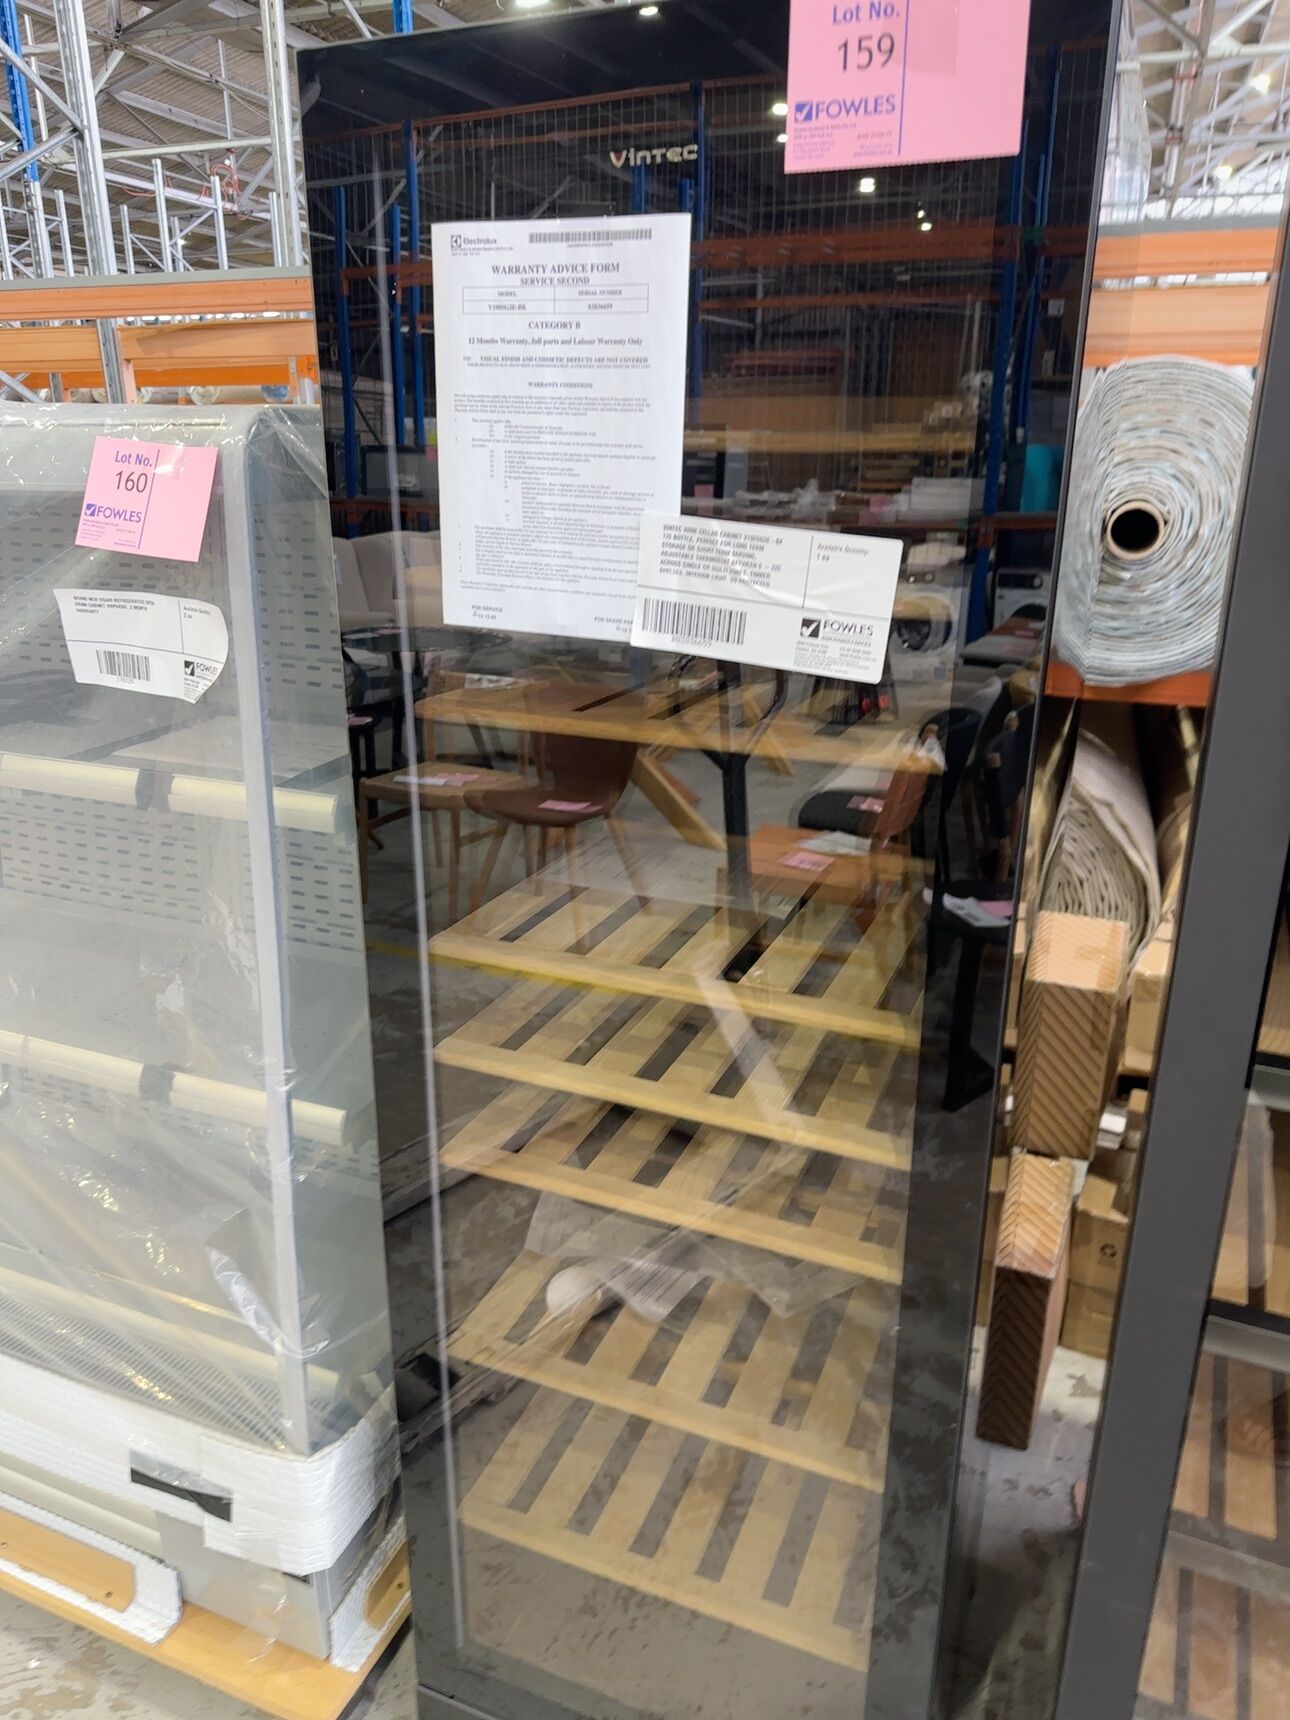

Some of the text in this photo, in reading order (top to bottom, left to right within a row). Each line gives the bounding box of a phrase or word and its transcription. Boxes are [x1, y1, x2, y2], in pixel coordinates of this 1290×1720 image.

[832, 0, 900, 26] Lot No.
[838, 32, 895, 72] 159
[815, 94, 896, 120] FOWLES
[463, 236, 497, 246] Electrolux
[491, 261, 620, 276] WARRANTY ADVICE FORM
[520, 276, 590, 286] SERVICE SECOND
[497, 290, 518, 298] MODEL
[599, 288, 623, 297] NUMBER
[528, 320, 581, 330] CATEGORY B
[468, 336, 475, 345] 12
[476, 336, 499, 345] Months
[532, 336, 542, 345] full
[543, 337, 560, 347] parts
[561, 336, 572, 345] and
[597, 337, 627, 347] Warranty
[628, 337, 642, 347] Only
[114, 451, 152, 467] Lot No.
[116, 470, 148, 493] 160
[96, 506, 142, 523] FOWLES
[823, 619, 874, 637] FOWLES
